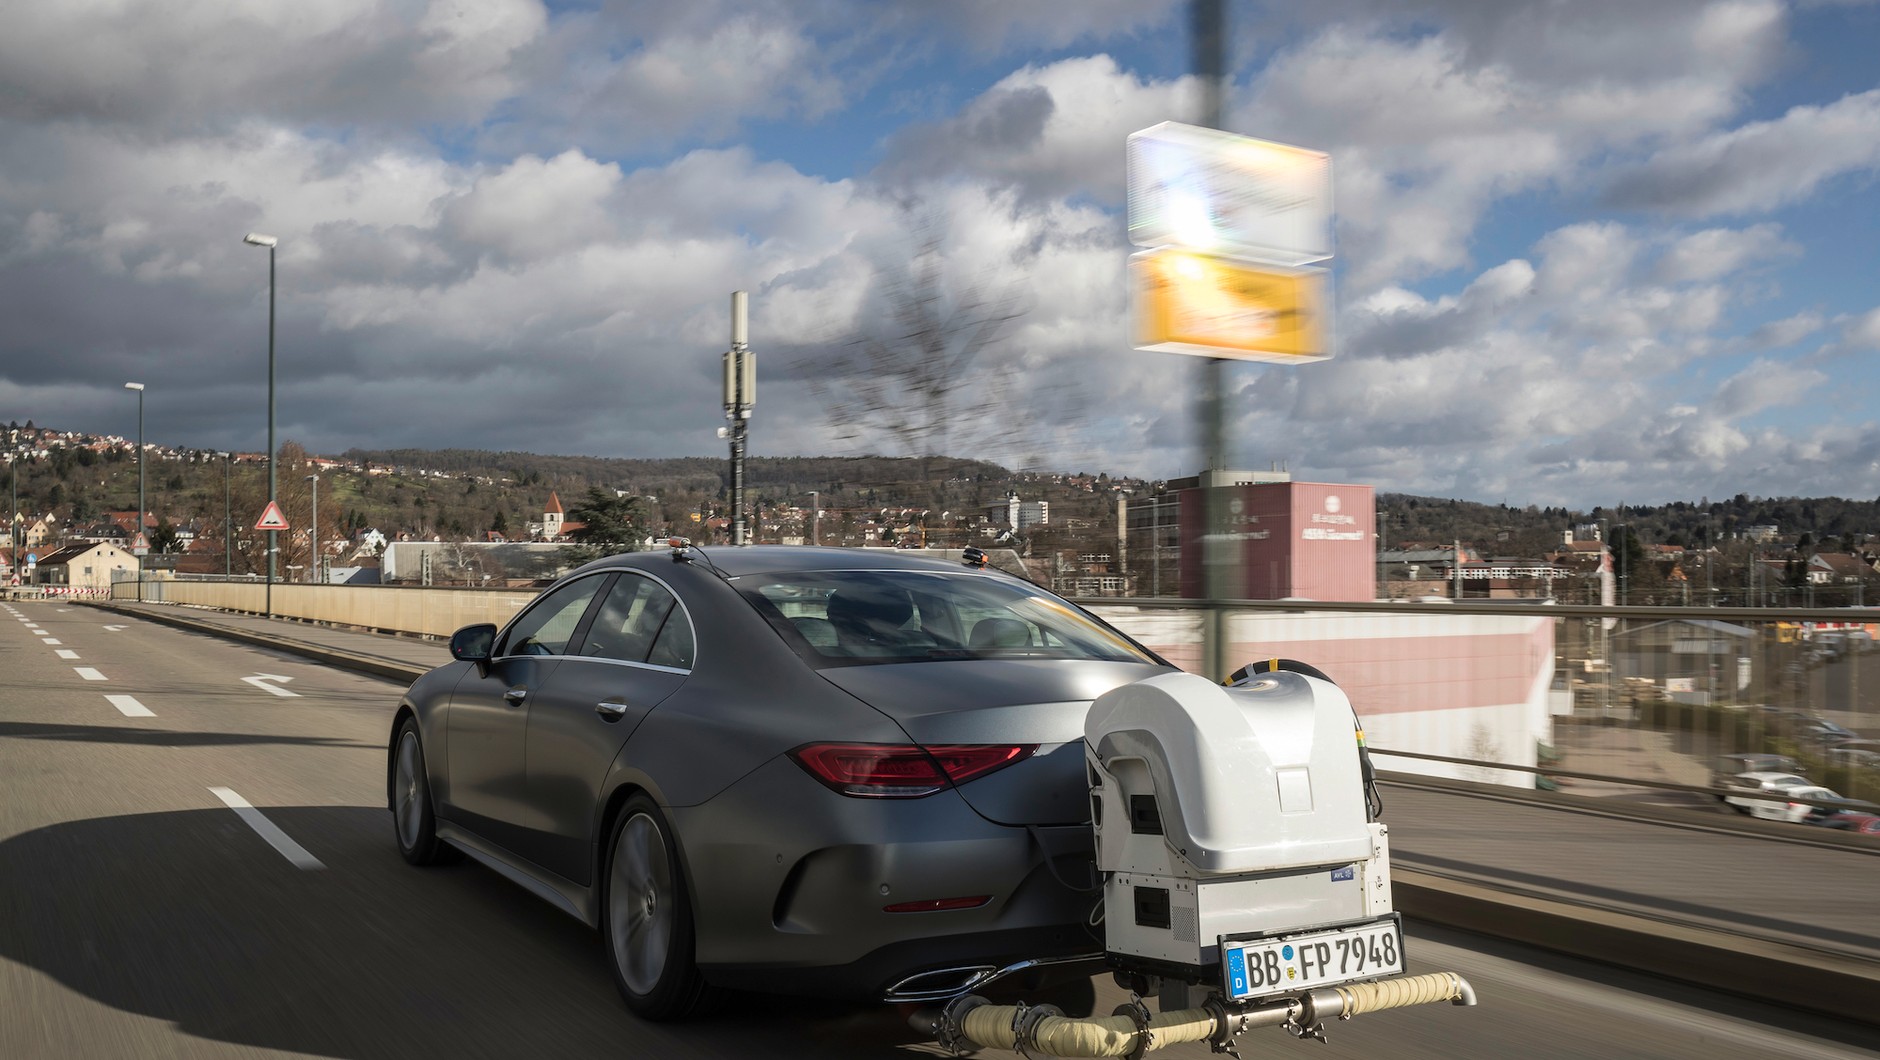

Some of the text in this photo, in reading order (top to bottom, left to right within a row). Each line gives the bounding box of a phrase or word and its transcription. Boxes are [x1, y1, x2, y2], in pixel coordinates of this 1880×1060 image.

[1246, 932, 1397, 988] BB FP 7948
[1235, 977, 1243, 989] D
